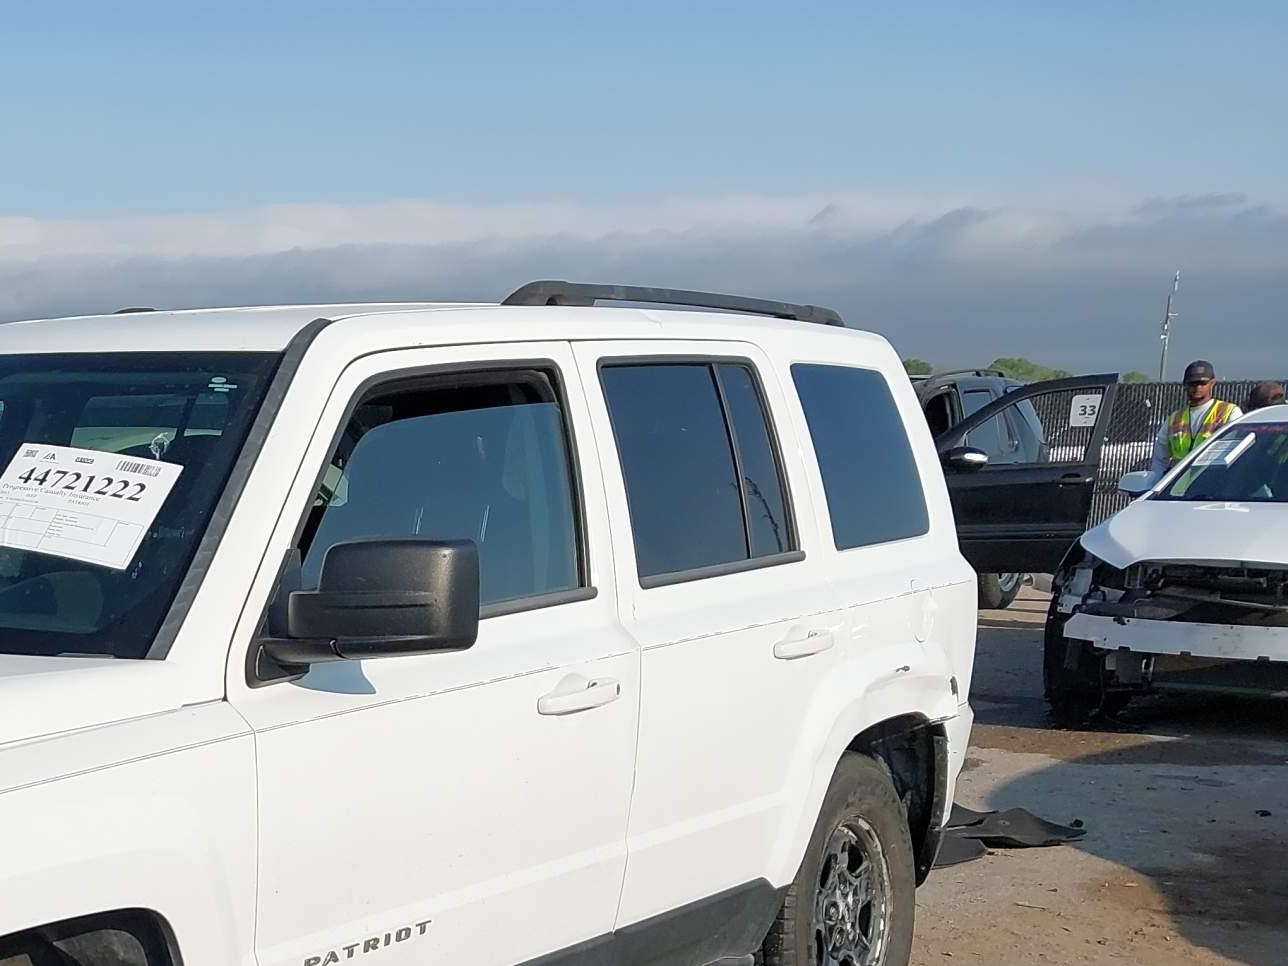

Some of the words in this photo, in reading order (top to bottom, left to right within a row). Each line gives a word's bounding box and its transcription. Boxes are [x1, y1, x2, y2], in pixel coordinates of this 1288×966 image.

[1078, 404, 1097, 417] 33
[2, 483, 40, 494] Progressive
[40, 487, 67, 497] Casualty
[68, 492, 102, 502] Insurance
[17, 466, 147, 502] 44721222
